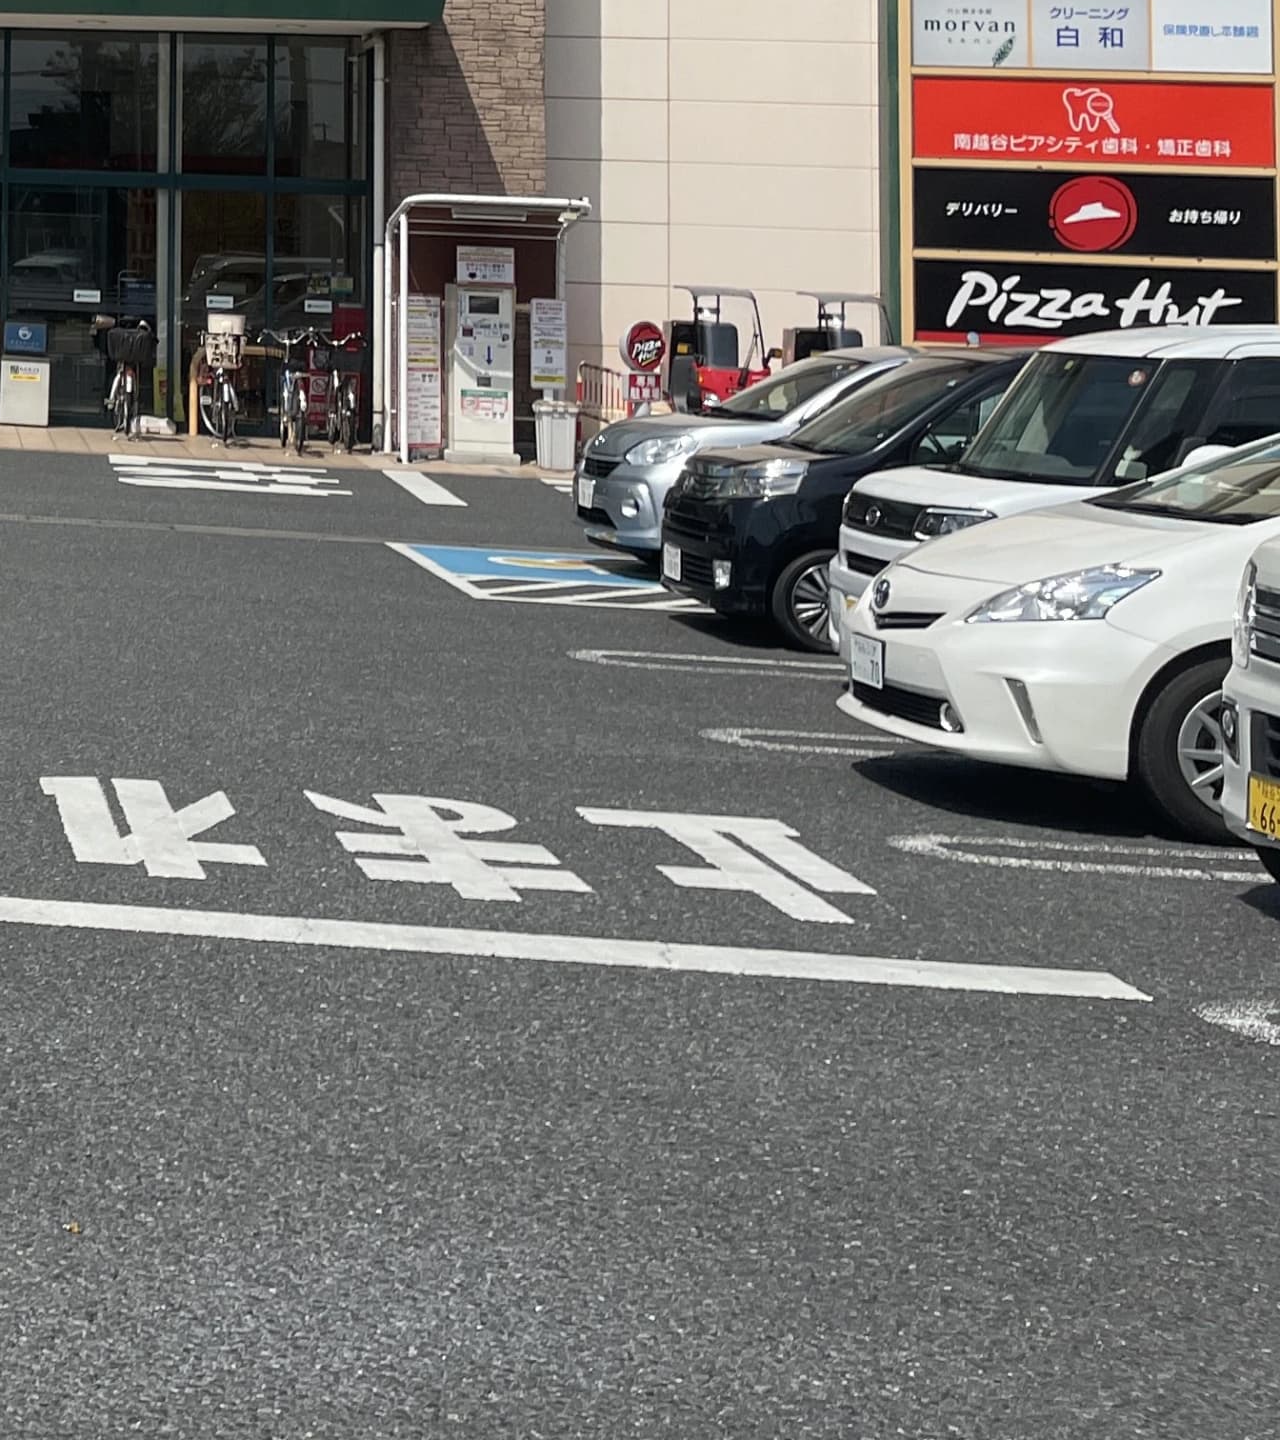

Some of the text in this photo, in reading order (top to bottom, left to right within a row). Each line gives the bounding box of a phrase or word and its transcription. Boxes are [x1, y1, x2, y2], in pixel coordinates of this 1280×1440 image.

[1049, 6, 1130, 21] クリーニング
[924, 19, 1016, 33] morvan
[945, 201, 1242, 225] デリバリー お持ち帰り
[945, 270, 1242, 328] Pizza Hut
[632, 340, 662, 359] Pizza
[40, 774, 878, 924] 止まれ
